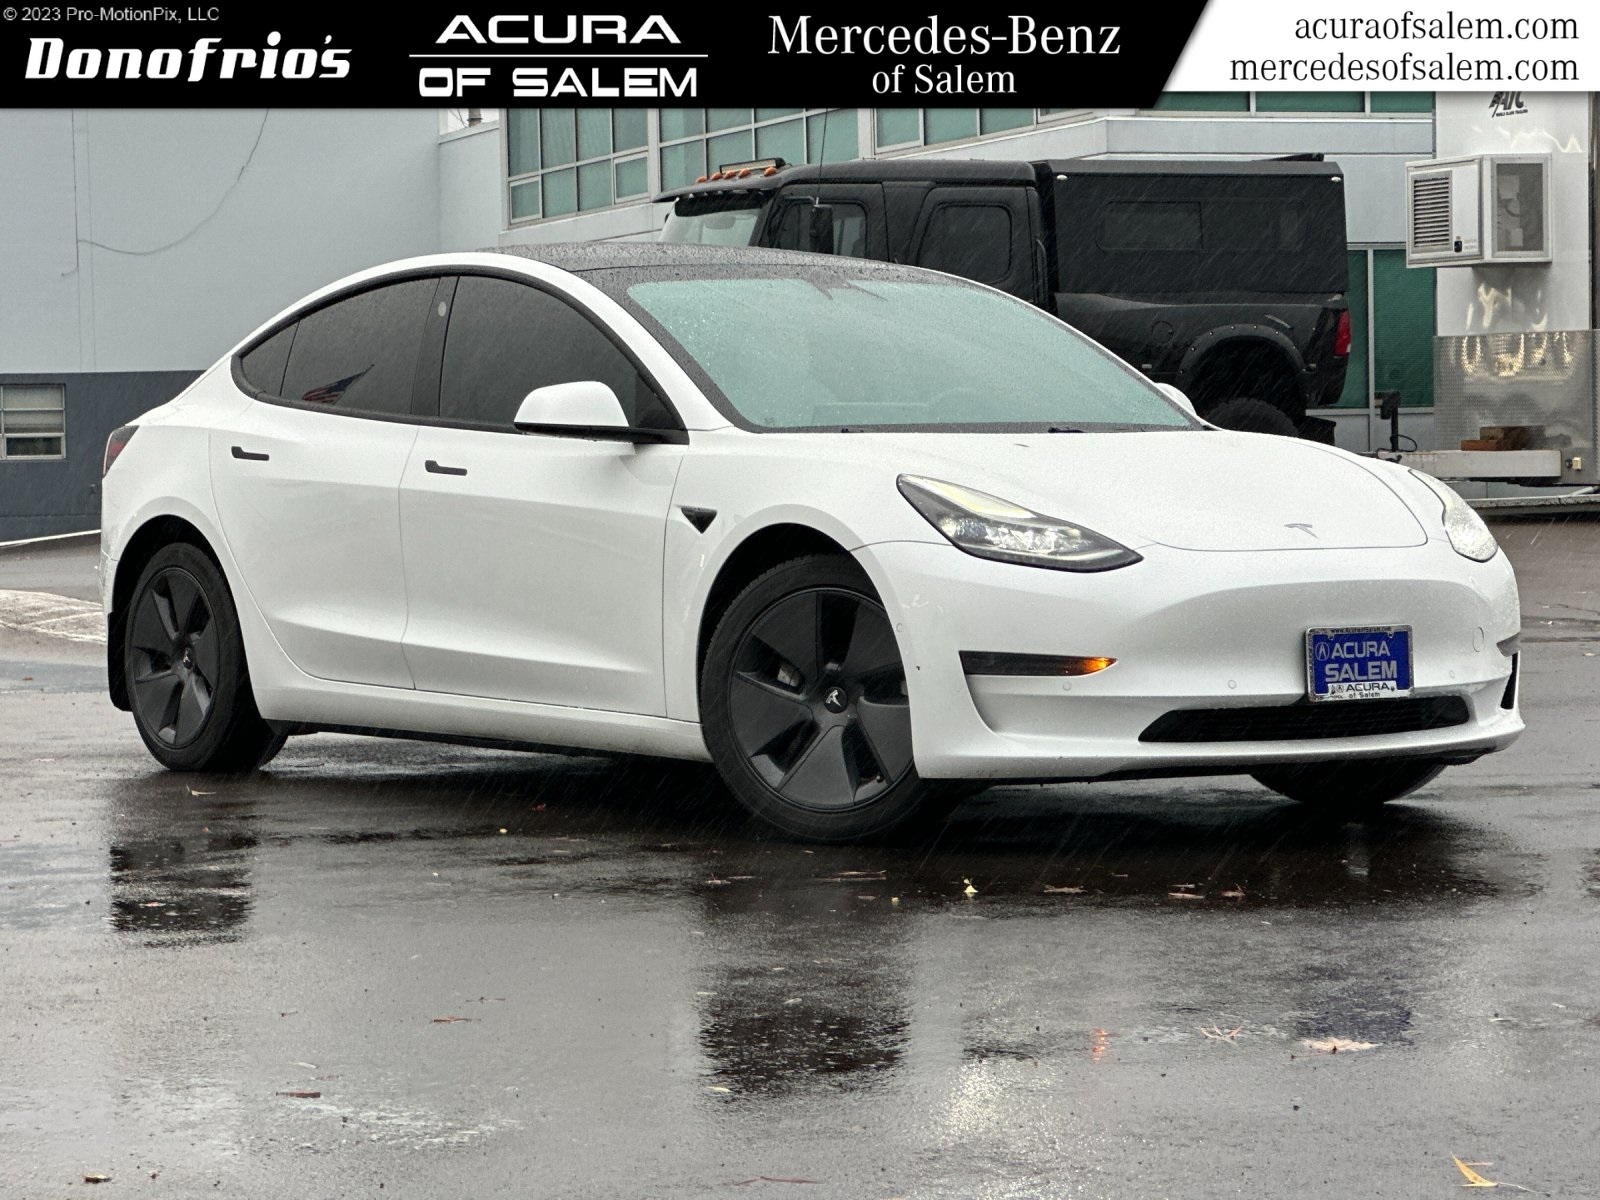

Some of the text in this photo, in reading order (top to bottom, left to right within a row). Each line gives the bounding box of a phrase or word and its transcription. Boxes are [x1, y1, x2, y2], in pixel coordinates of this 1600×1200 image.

[1331, 641, 1391, 659] ACURA
[1325, 660, 1398, 682] SALEM
[1346, 682, 1390, 692] ACURA
